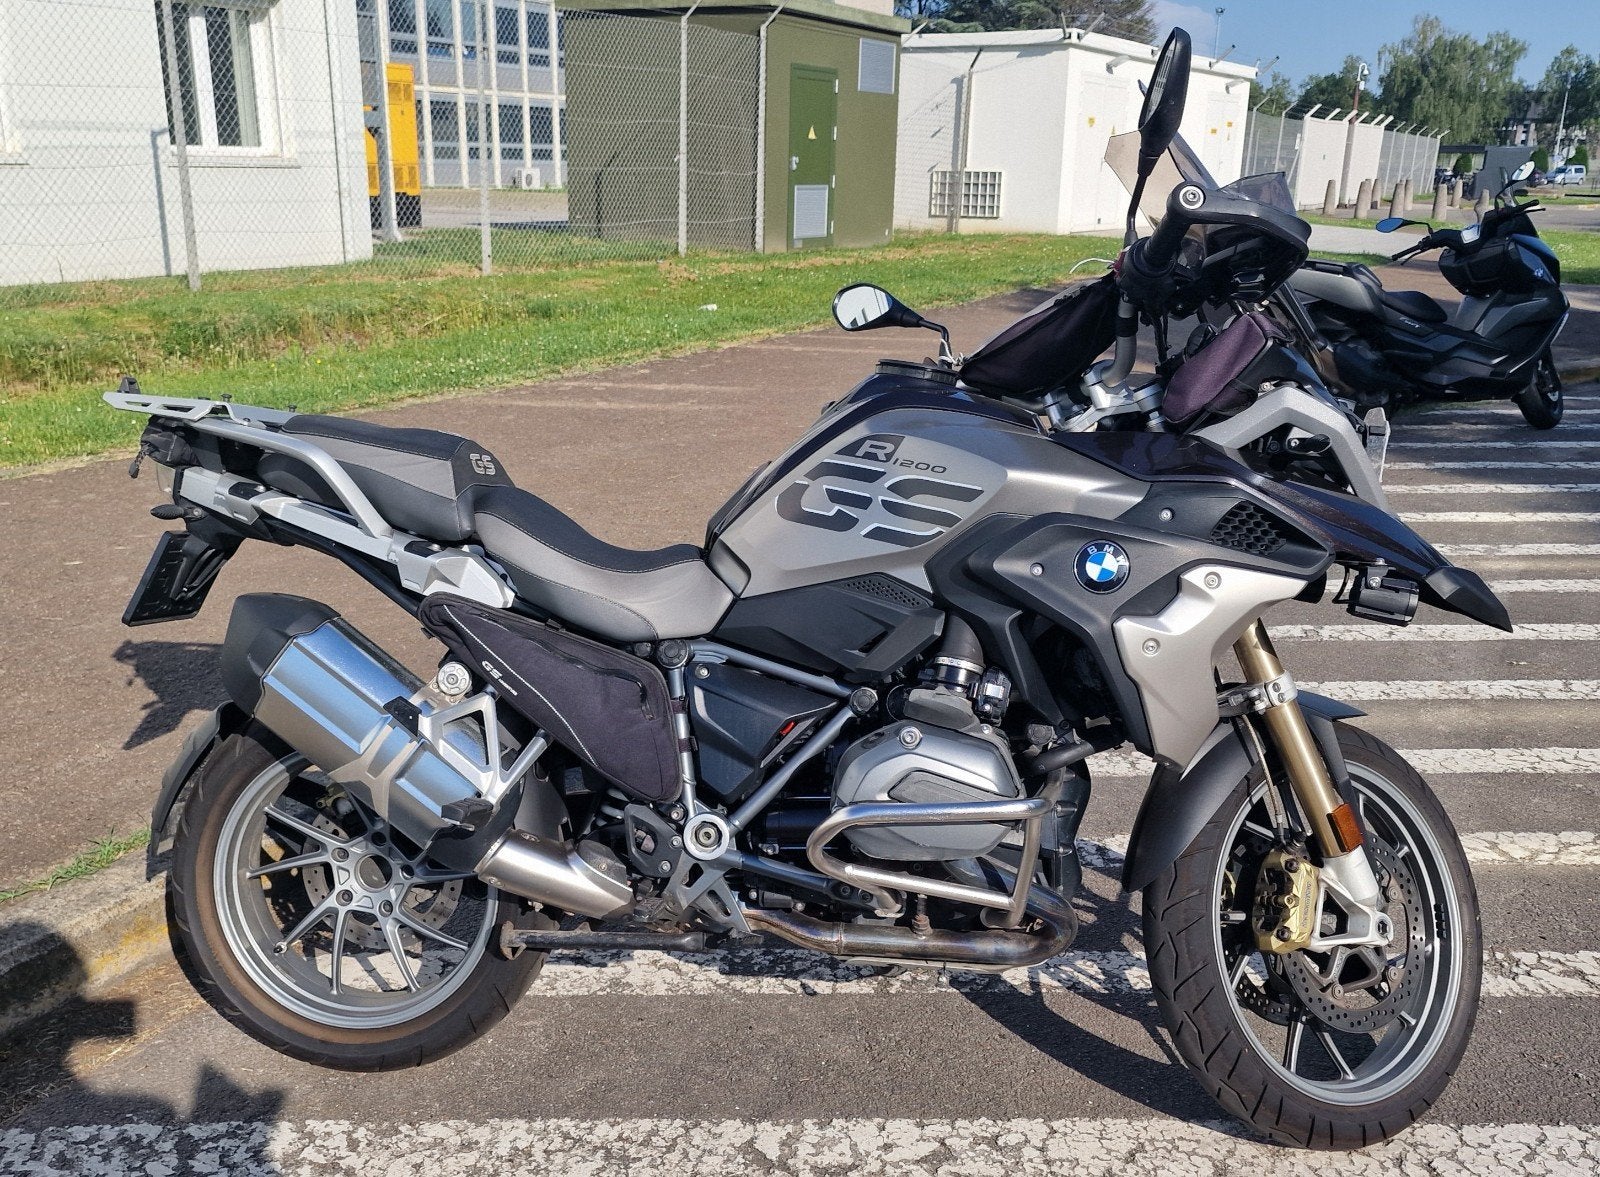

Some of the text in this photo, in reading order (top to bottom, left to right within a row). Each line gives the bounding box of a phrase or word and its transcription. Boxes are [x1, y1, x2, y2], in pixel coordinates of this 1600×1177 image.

[469, 453, 496, 475] GS
[854, 439, 947, 474] R 1200
[775, 458, 985, 548] GS
[1086, 544, 1128, 567] BMW
